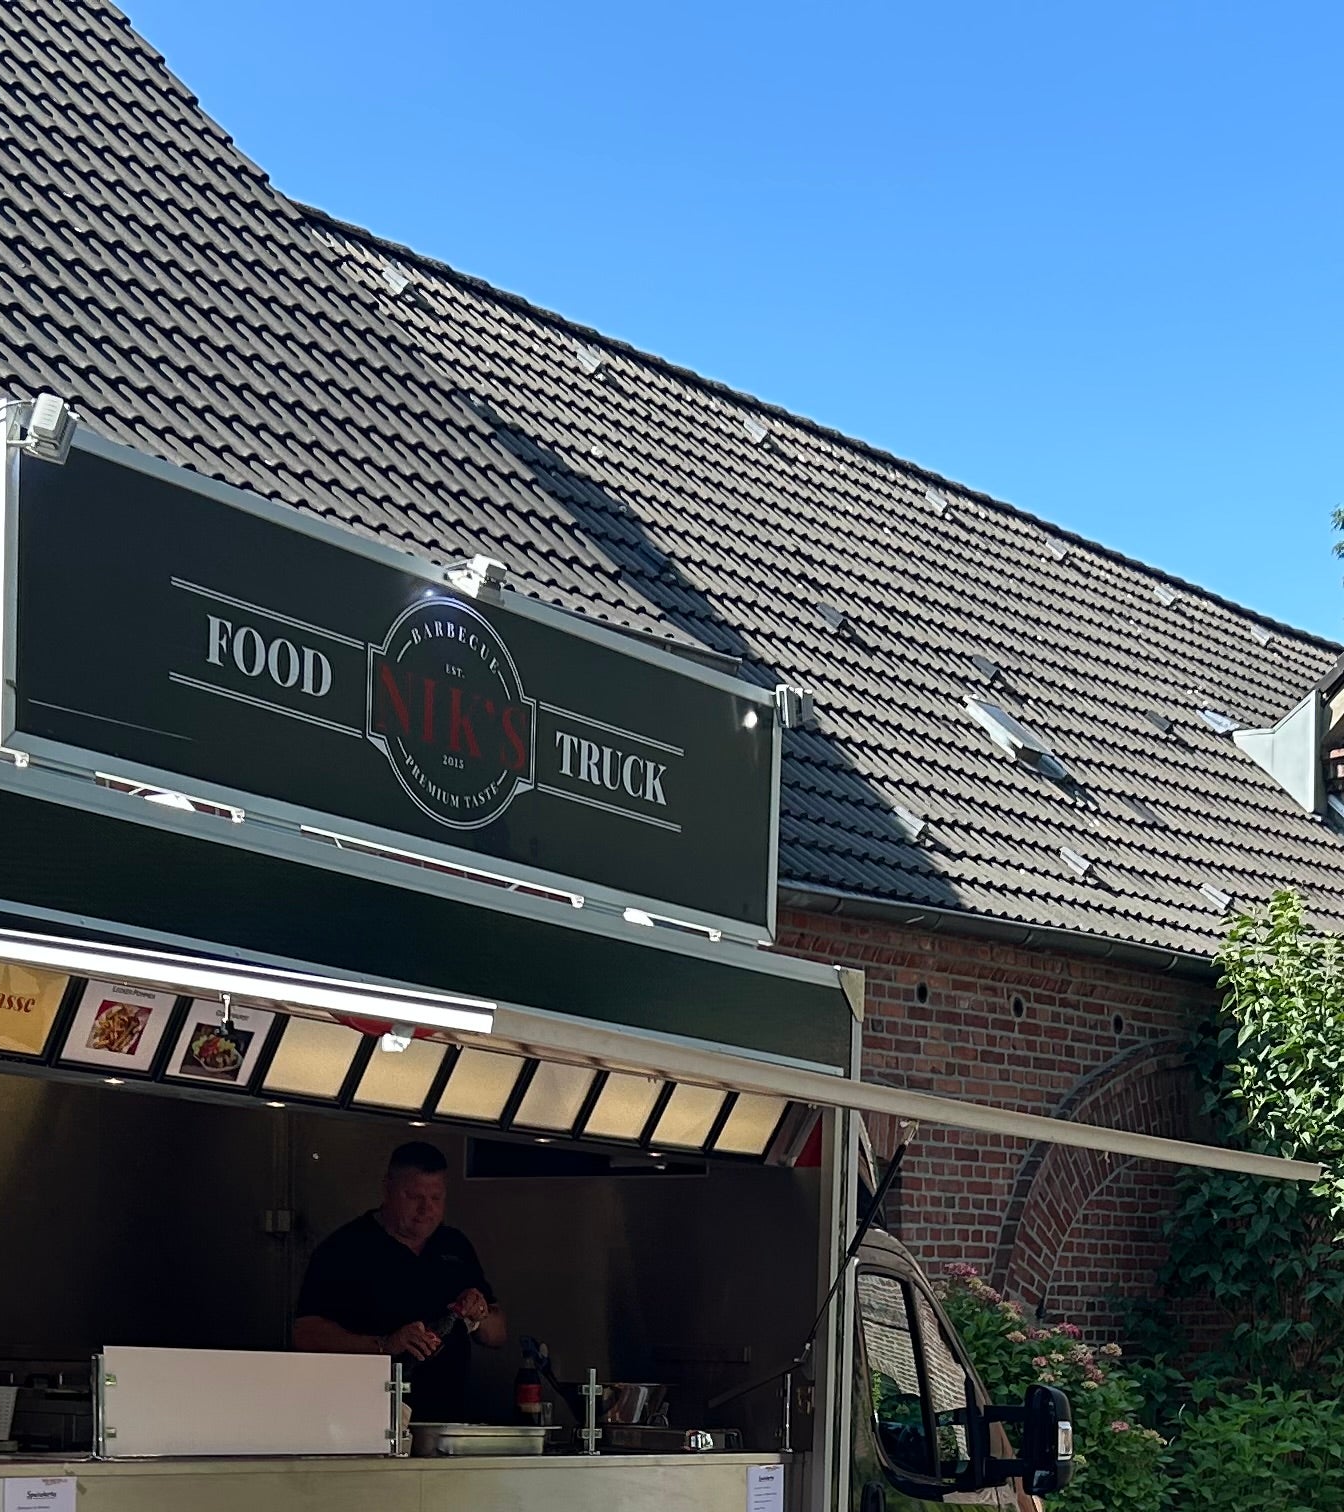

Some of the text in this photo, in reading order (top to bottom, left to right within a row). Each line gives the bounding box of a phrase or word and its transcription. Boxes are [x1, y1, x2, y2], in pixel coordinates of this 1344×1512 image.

[410, 620, 500, 674] BARBECUE
[445, 663, 465, 679] EST.
[206, 614, 667, 806] FOOD TRUCK
[375, 661, 528, 771] NIK'S
[405, 755, 499, 809] PREMIUM TASTE
[442, 754, 465, 770] 2015
